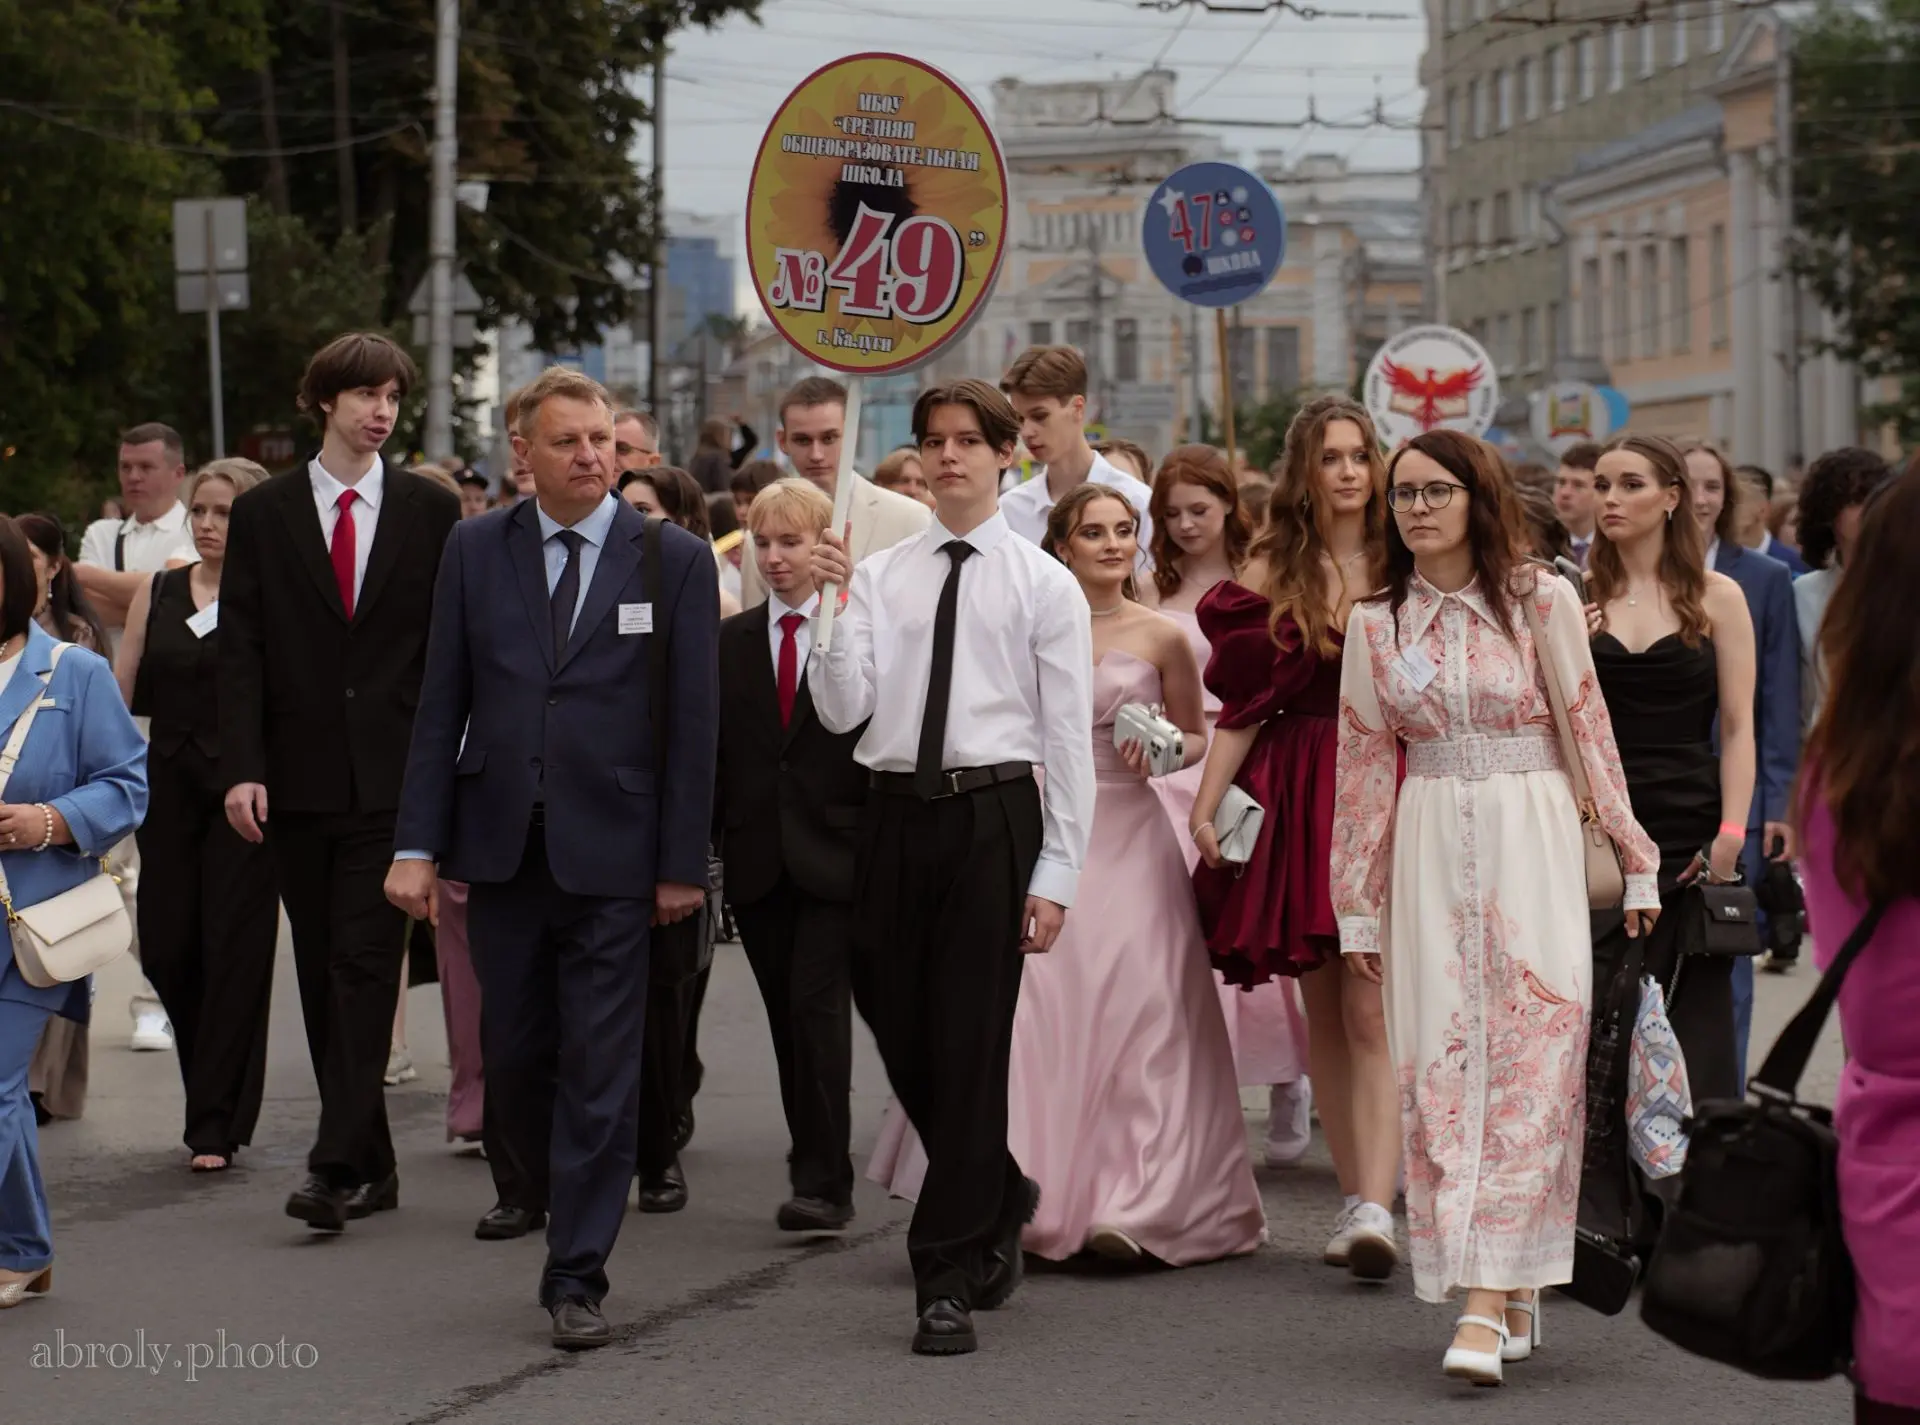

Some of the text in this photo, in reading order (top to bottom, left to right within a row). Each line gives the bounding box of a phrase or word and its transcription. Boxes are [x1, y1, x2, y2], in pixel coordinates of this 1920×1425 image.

[858, 93, 903, 114] МБОУ
[782, 134, 980, 171] ОБЩЕОБРАЗОВАТЕЛЬНАЯ
[841, 164, 904, 187] ШКОЛА
[1169, 193, 1212, 253] 47
